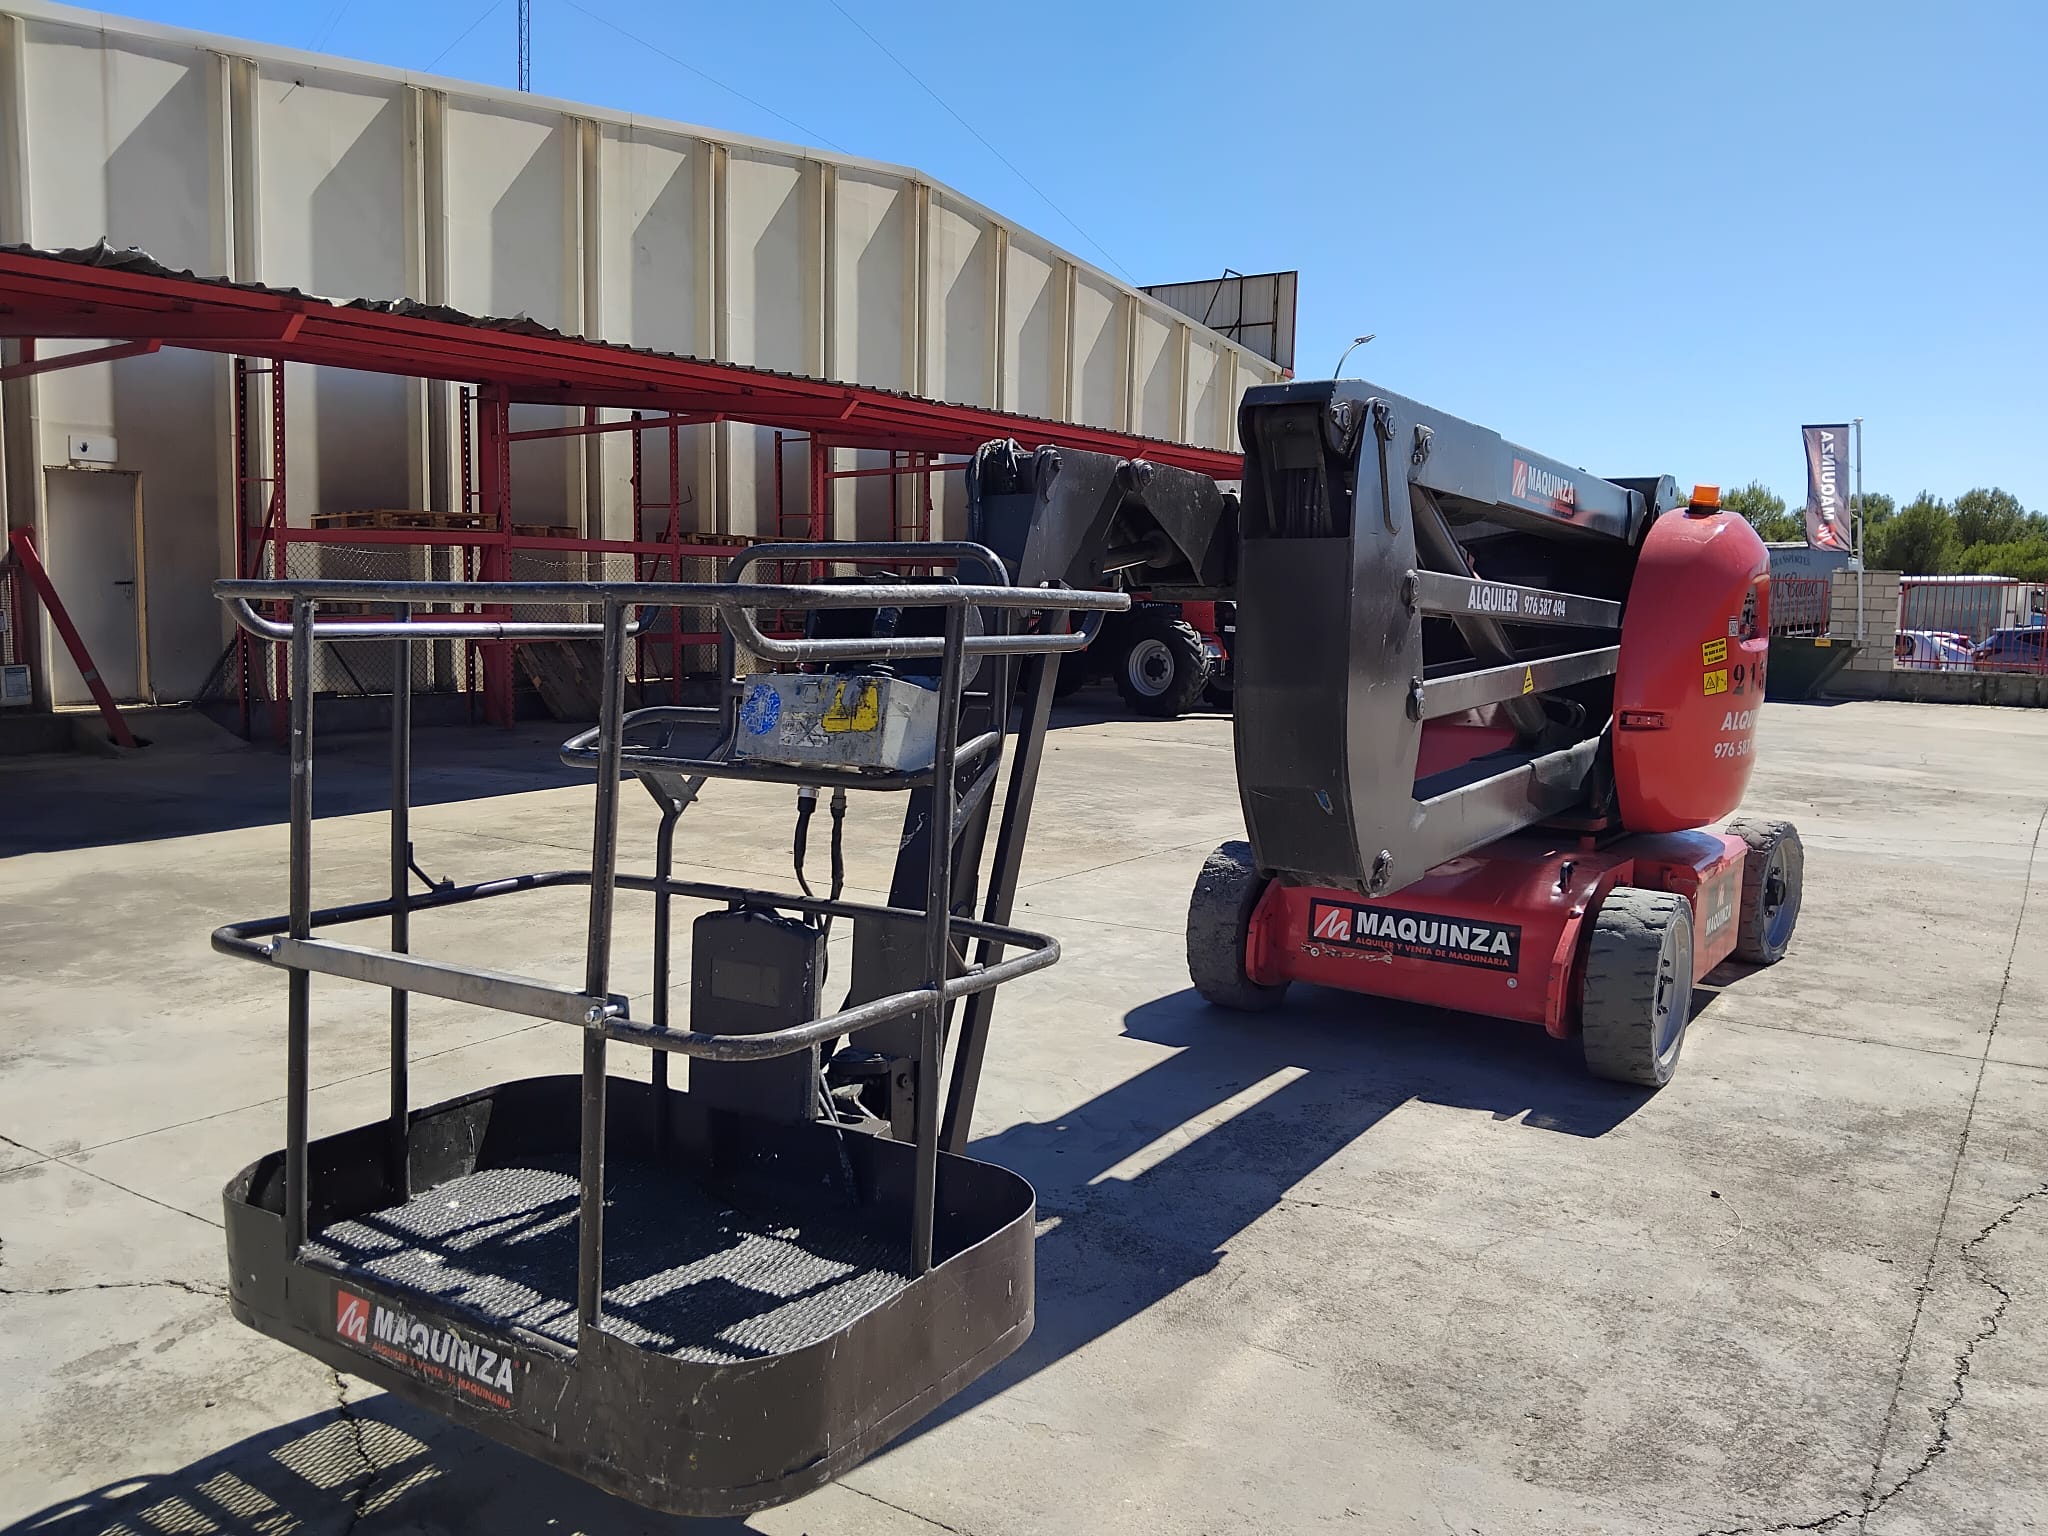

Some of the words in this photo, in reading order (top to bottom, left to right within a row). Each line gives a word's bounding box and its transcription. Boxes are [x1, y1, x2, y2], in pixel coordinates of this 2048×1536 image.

[1528, 466, 1574, 504] MAQUINZA
[1468, 585, 1518, 612] ALQUILER
[1524, 596, 1538, 614] 976
[1539, 598, 1552, 616] 587
[1553, 600, 1566, 617] 494
[1714, 742, 1735, 759] 976
[1355, 937, 1394, 949] ALQUILER
[1396, 942, 1402, 950] Y
[1405, 945, 1432, 955] VENTA
[1435, 949, 1446, 957] DE
[1449, 952, 1509, 967] MAQUINARIA
[1356, 911, 1511, 956] MAQUINZA
[373, 1306, 514, 1394] MAQUINZA
[409, 1356, 415, 1366] Y
[458, 1377, 511, 1409] MAQUINARIA
